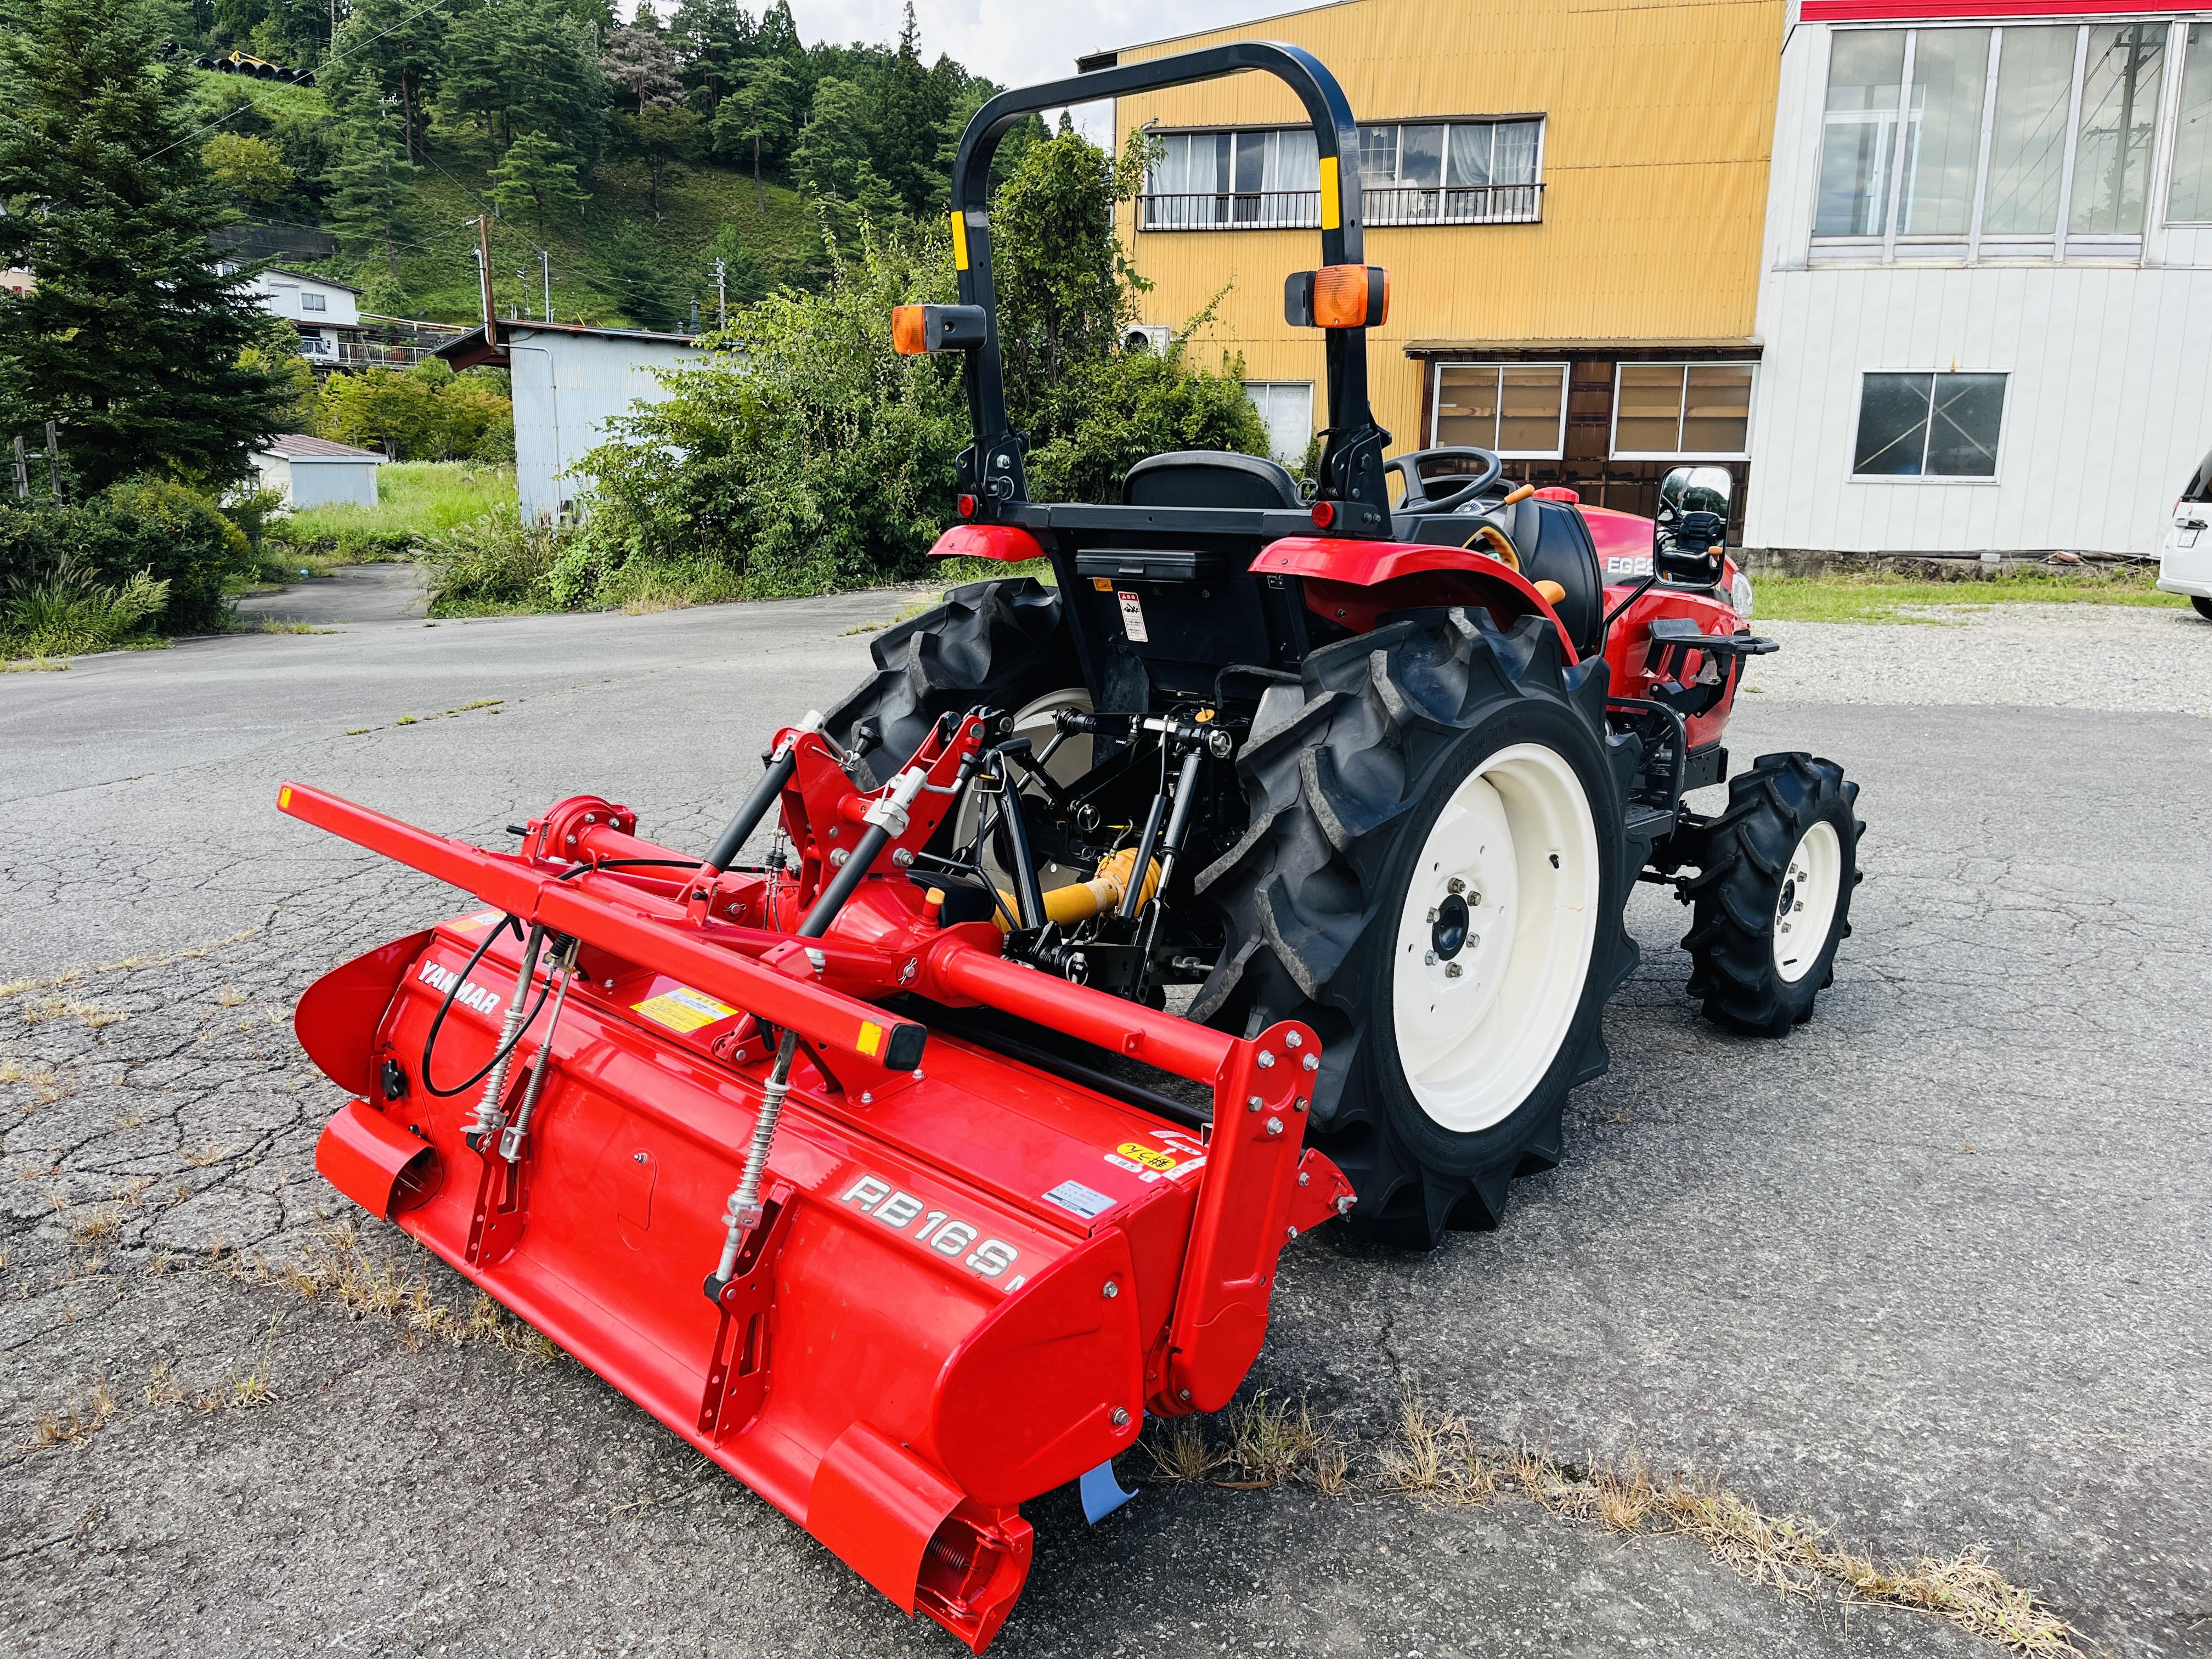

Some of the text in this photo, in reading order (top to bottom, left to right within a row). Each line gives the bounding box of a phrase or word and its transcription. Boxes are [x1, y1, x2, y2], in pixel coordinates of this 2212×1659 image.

[417, 959, 502, 1015] YANMAR
[1125, 1144, 1172, 1168] 耕うん
